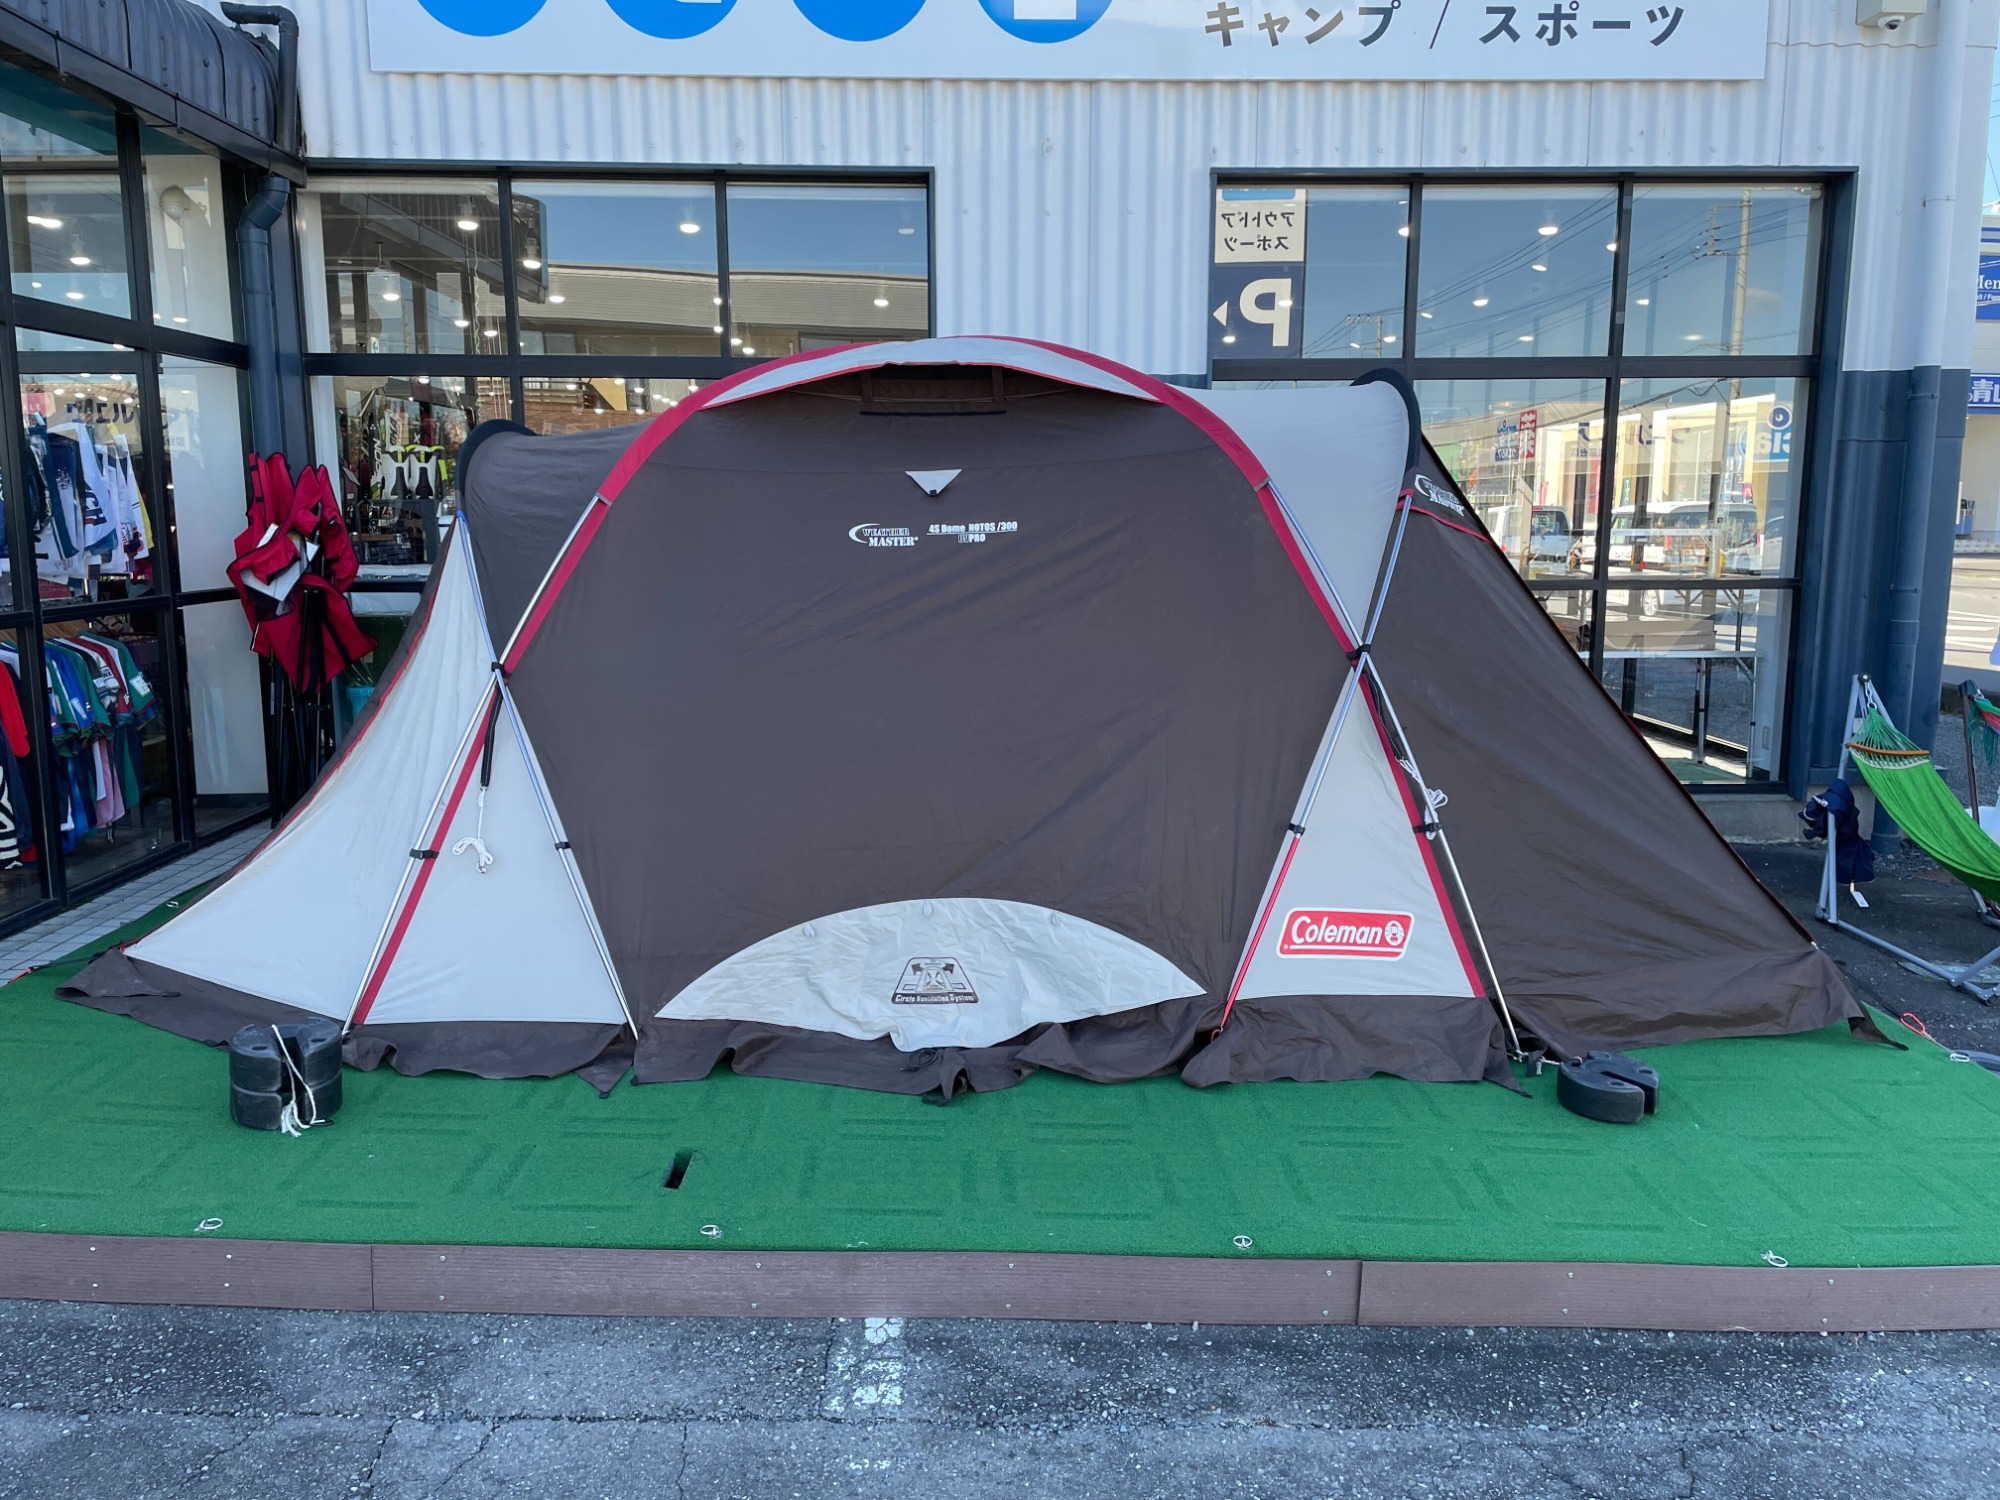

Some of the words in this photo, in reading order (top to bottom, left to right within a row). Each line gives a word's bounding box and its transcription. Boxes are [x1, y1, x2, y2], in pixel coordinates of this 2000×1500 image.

[1204, 0, 1401, 48] キャンプ
[1479, 0, 1685, 47] スポーツ
[862, 527, 911, 537] WEATHER
[928, 524, 940, 533] 4S
[941, 524, 966, 533] Dome
[968, 522, 996, 532] NOTOS
[868, 536, 917, 547] MASTER
[1291, 914, 1383, 945] Coleman
